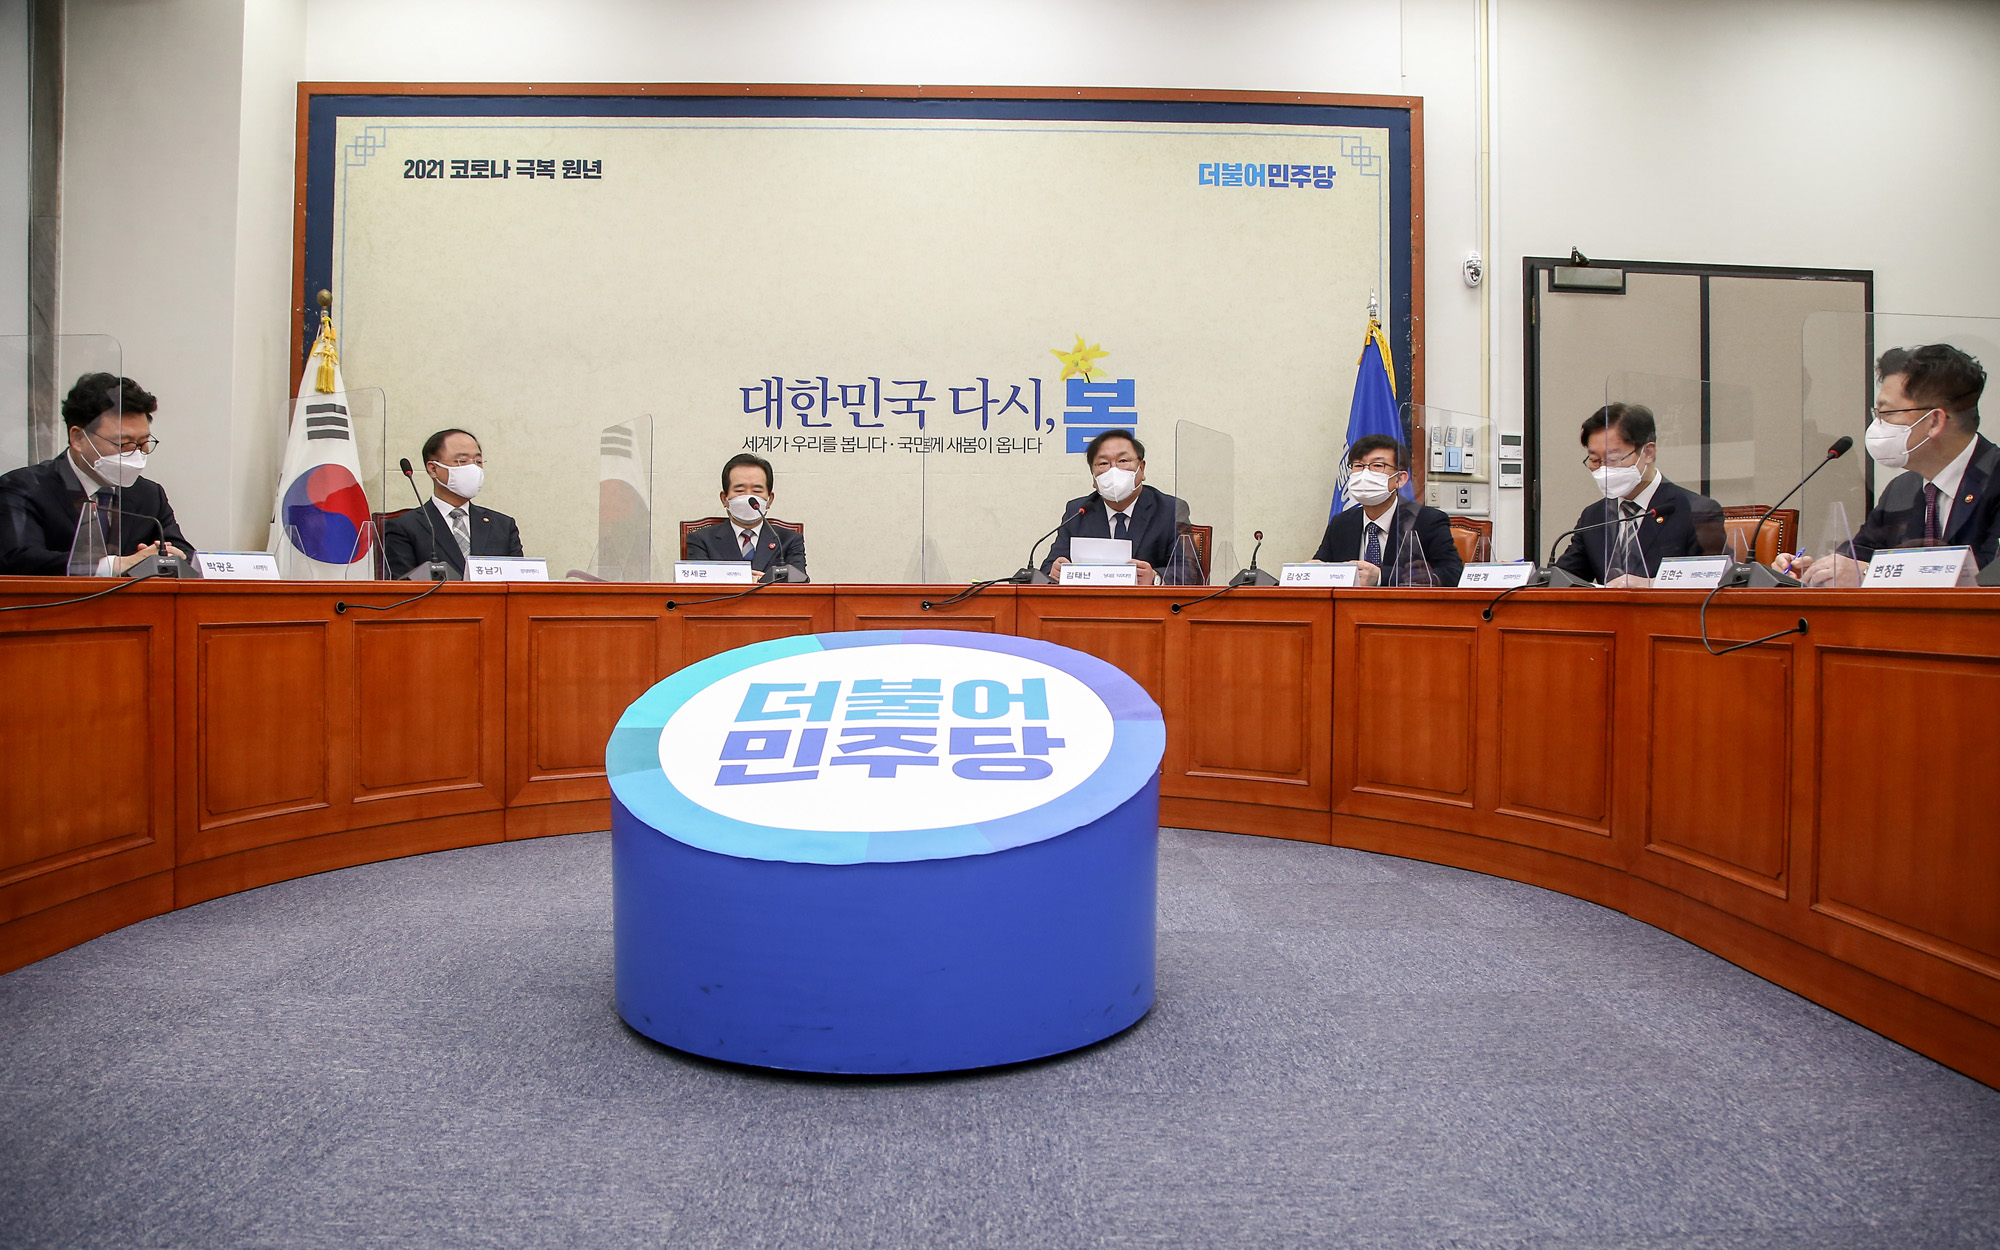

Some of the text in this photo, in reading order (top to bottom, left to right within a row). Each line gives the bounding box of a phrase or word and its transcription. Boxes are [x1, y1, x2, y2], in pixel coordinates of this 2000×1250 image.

[403, 159, 602, 179] 2021 코로나 극복 원년
[1198, 163, 1337, 189] 더불어민주당
[739, 376, 1137, 453] 대한민국 다시, 봄
[742, 436, 789, 452] 세계가
[791, 436, 838, 453] 우리를
[840, 436, 887, 453] 봅니다
[947, 436, 992, 453] 새봄이
[996, 436, 1043, 454] 옵니다
[206, 561, 235, 573] 박광온
[681, 569, 707, 578] 정세균
[1873, 563, 1904, 578] 변창흠
[1066, 571, 1091, 580] 김태년
[1286, 572, 1311, 581] 김상조
[1466, 573, 1489, 582] 박범계
[1660, 569, 1683, 581] 김현수
[734, 678, 1049, 723] 더불어
[714, 726, 1066, 786] 민주당
